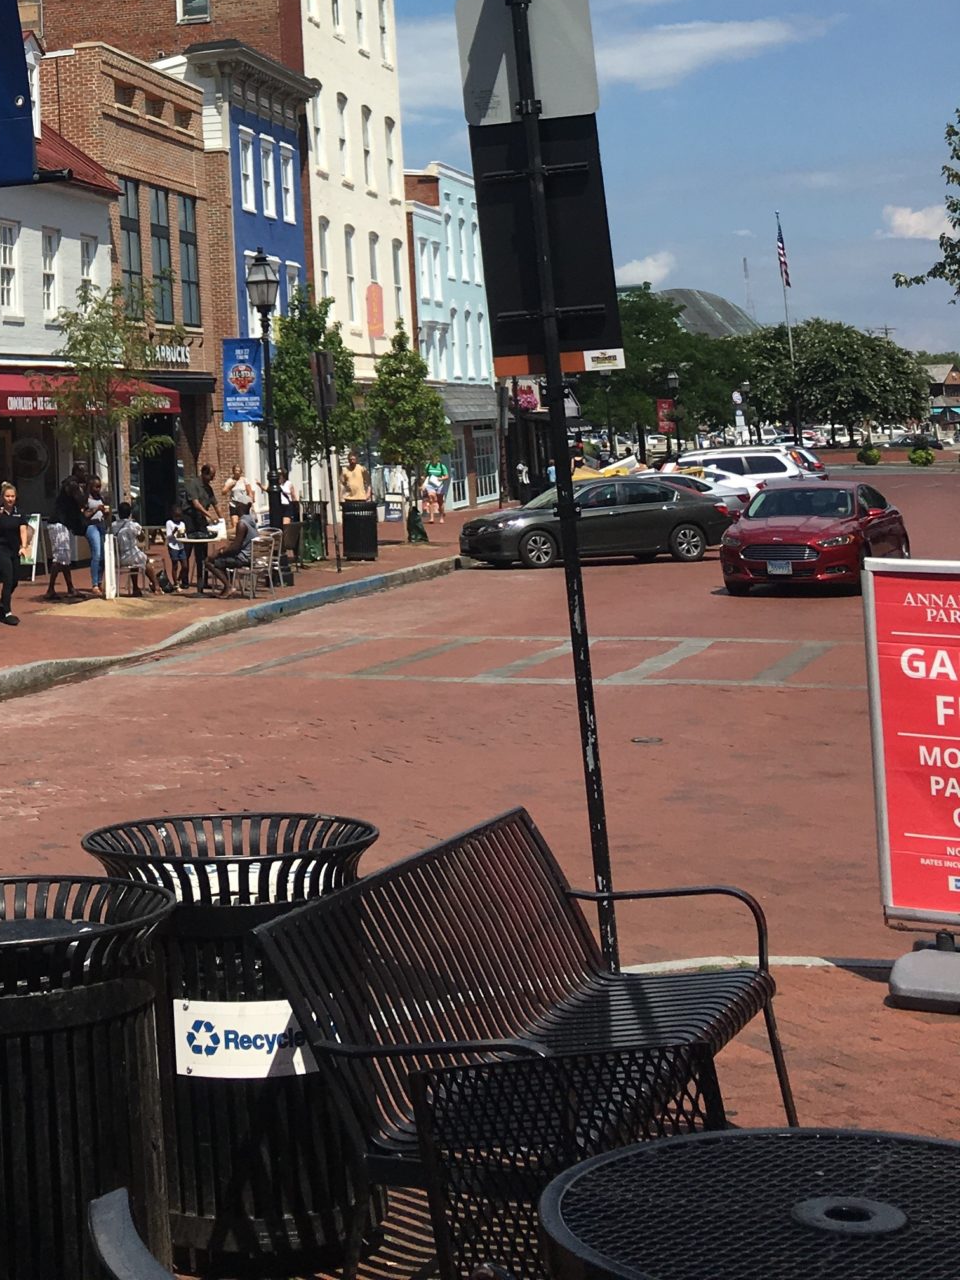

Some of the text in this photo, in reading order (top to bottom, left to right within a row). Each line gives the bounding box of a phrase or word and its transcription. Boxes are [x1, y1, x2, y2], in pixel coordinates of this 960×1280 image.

[903, 591, 960, 609] ANNA
[900, 647, 960, 681] GA
[936, 694, 960, 727] F
[920, 858, 943, 867] RATES
[223, 1028, 306, 1054] Recycle
